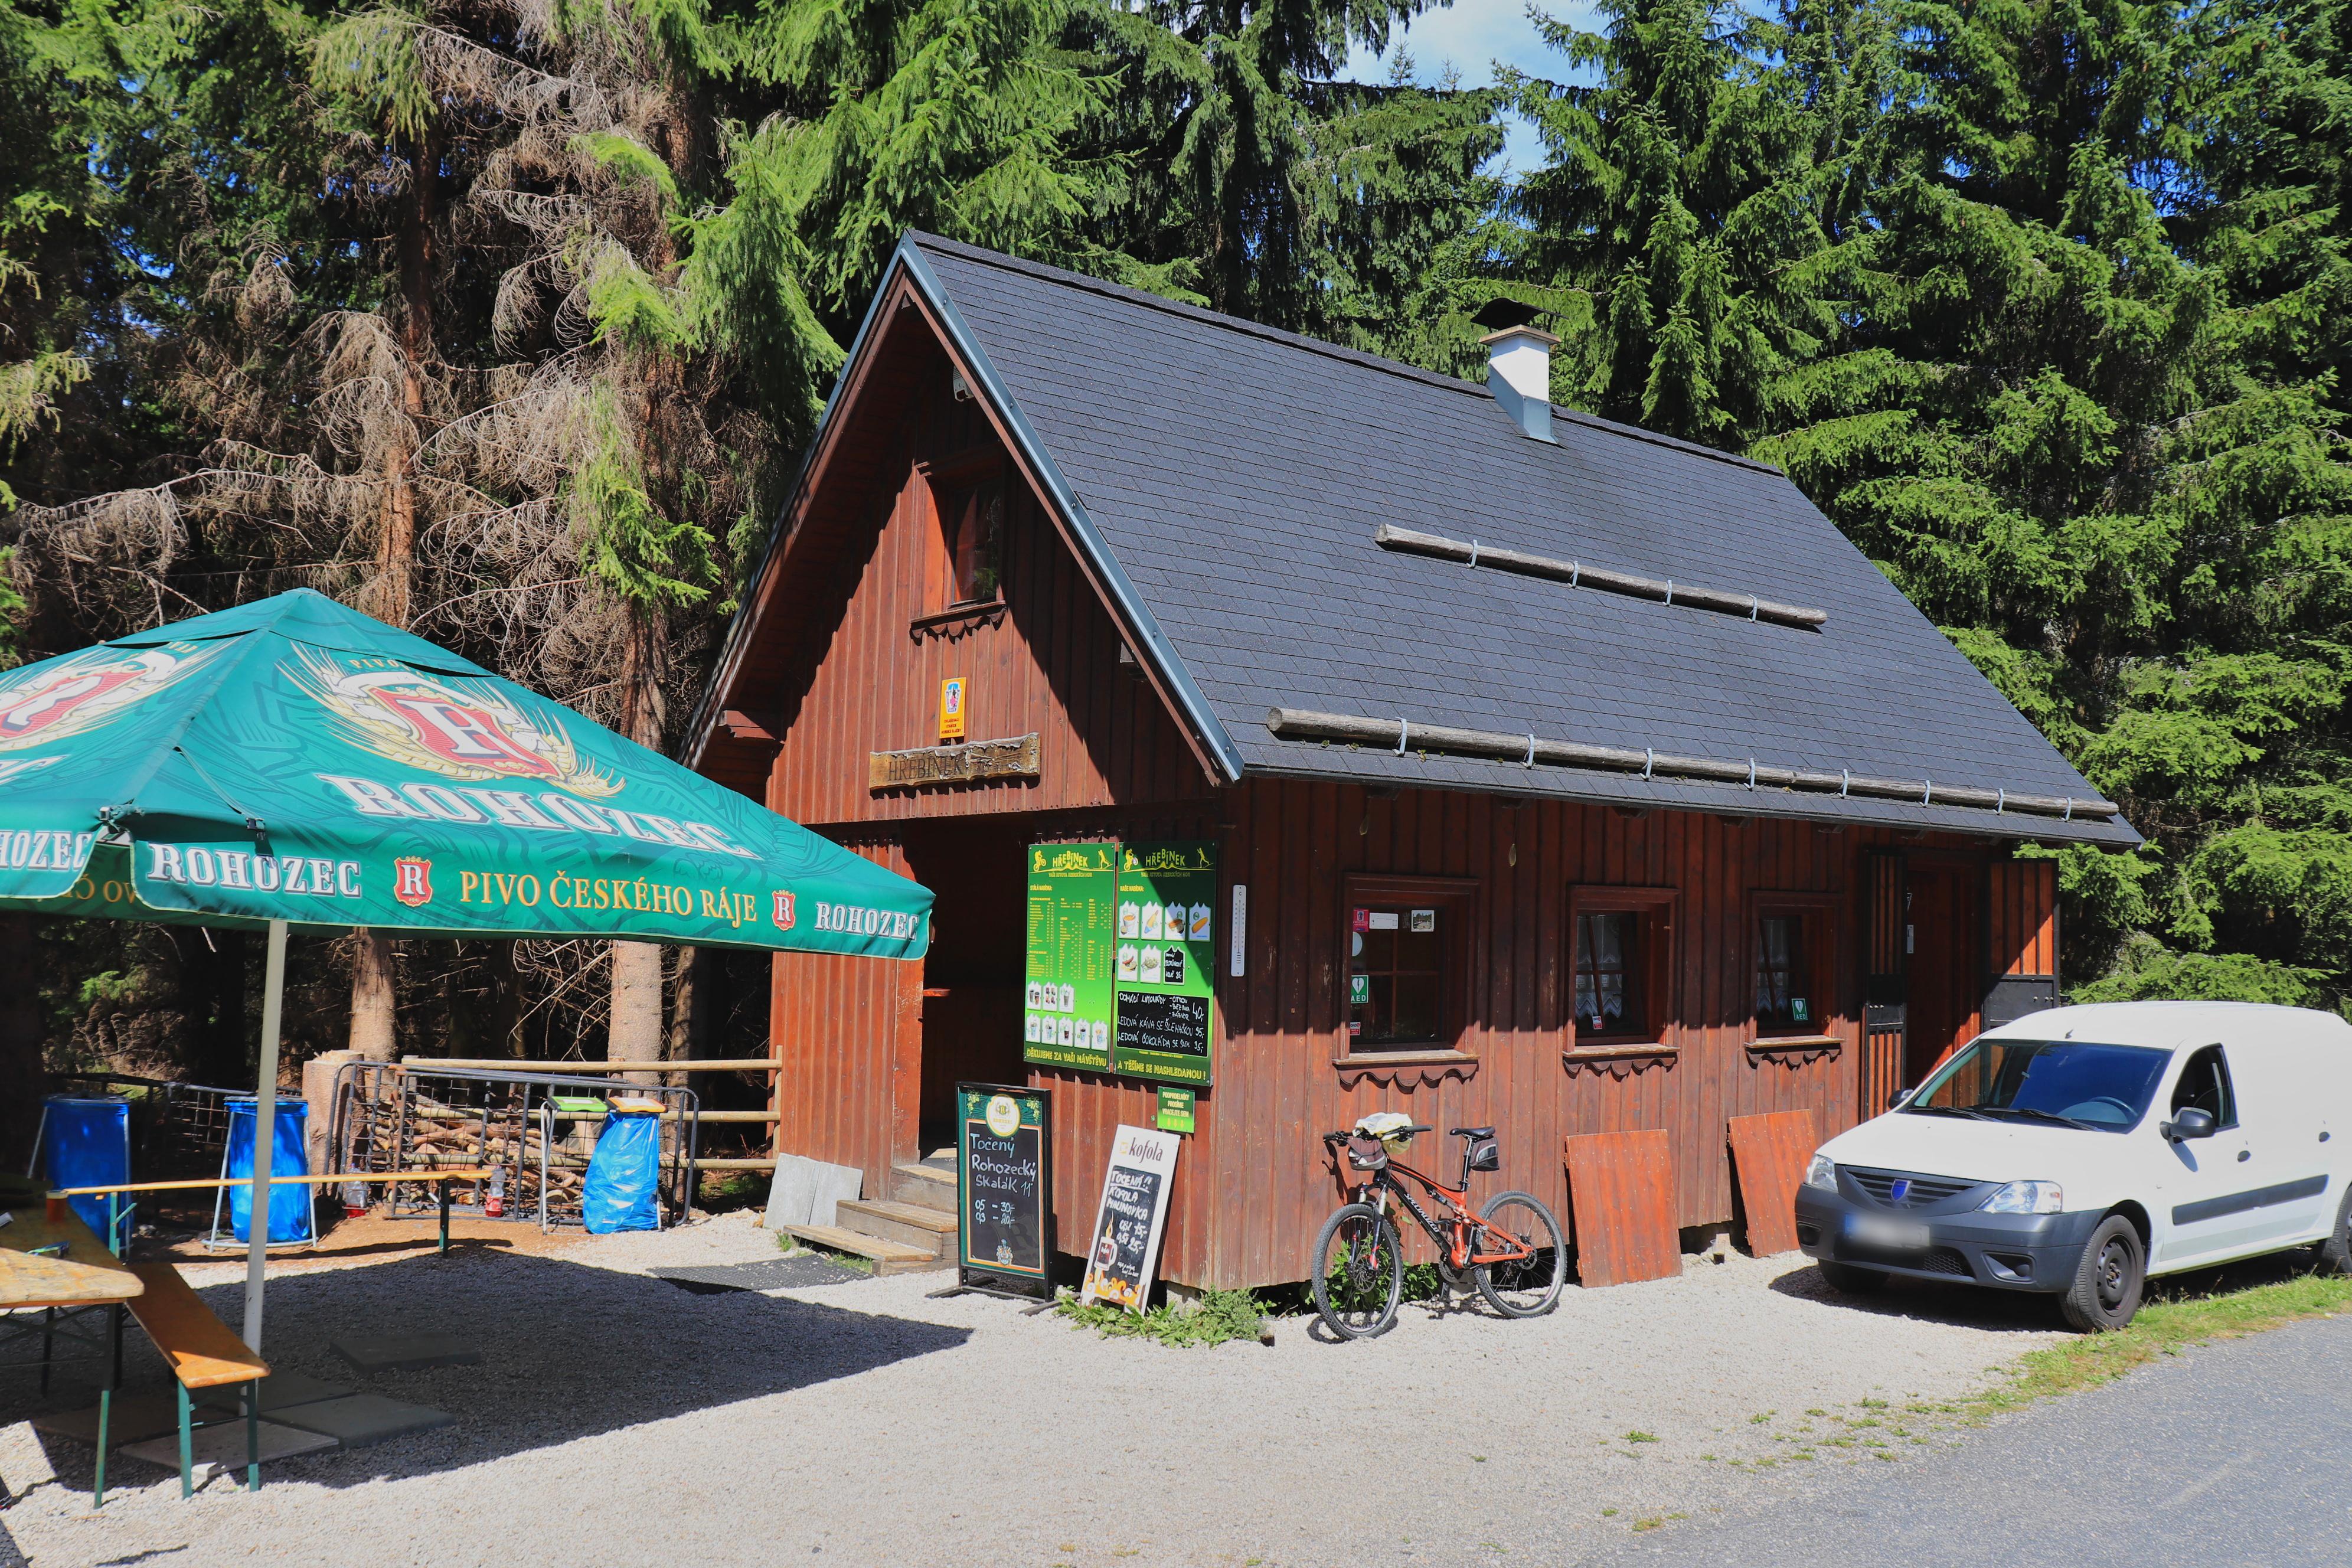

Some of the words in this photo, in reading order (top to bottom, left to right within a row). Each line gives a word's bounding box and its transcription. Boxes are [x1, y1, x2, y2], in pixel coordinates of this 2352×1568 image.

[314, 774, 762, 860] ROHOZEC
[1053, 850, 1088, 867] HŘEBÍNEK
[1146, 848, 1185, 867] HŘEBÍNEK
[147, 842, 362, 899] ROHOZEC
[460, 871, 541, 907] PIVO
[548, 870, 693, 916] ČESKÉHO
[700, 886, 757, 929] RÁJE
[814, 902, 919, 940] ROHOZEC
[1119, 992, 1139, 1004] DOMÁCÍ
[1141, 995, 1165, 1005] LIMONÁDY
[1118, 1014, 1139, 1027] LEDOVÁ
[1139, 1017, 1155, 1030] KÁVA
[1156, 1020, 1164, 1030] SE
[1118, 1031, 1139, 1044] LEDOVÁ
[1142, 1033, 1170, 1048] ČOKOLÁDA
[1172, 1039, 1178, 1048] SE
[1027, 1047, 1053, 1060] DĚKUJEME
[1054, 1051, 1062, 1061] ZA
[1063, 1051, 1075, 1063] VAŠI
[1077, 1053, 1107, 1067] NÁVŠTĚVU
[1118, 1060, 1122, 1070] A
[1124, 1059, 1144, 1072] TĚŠÍME
[1145, 1064, 1152, 1073] SE
[1154, 1064, 1202, 1080] NASHLEDANOU
[970, 1132, 1015, 1158] Točený
[1128, 1137, 1163, 1163] kofola
[971, 1154, 1037, 1182] Rohozecký
[1108, 1186, 1138, 1203] KOFOLA
[1106, 1197, 1148, 1221] MALINOVKA
[1404, 1193, 1439, 1233] SPECIALIZED
